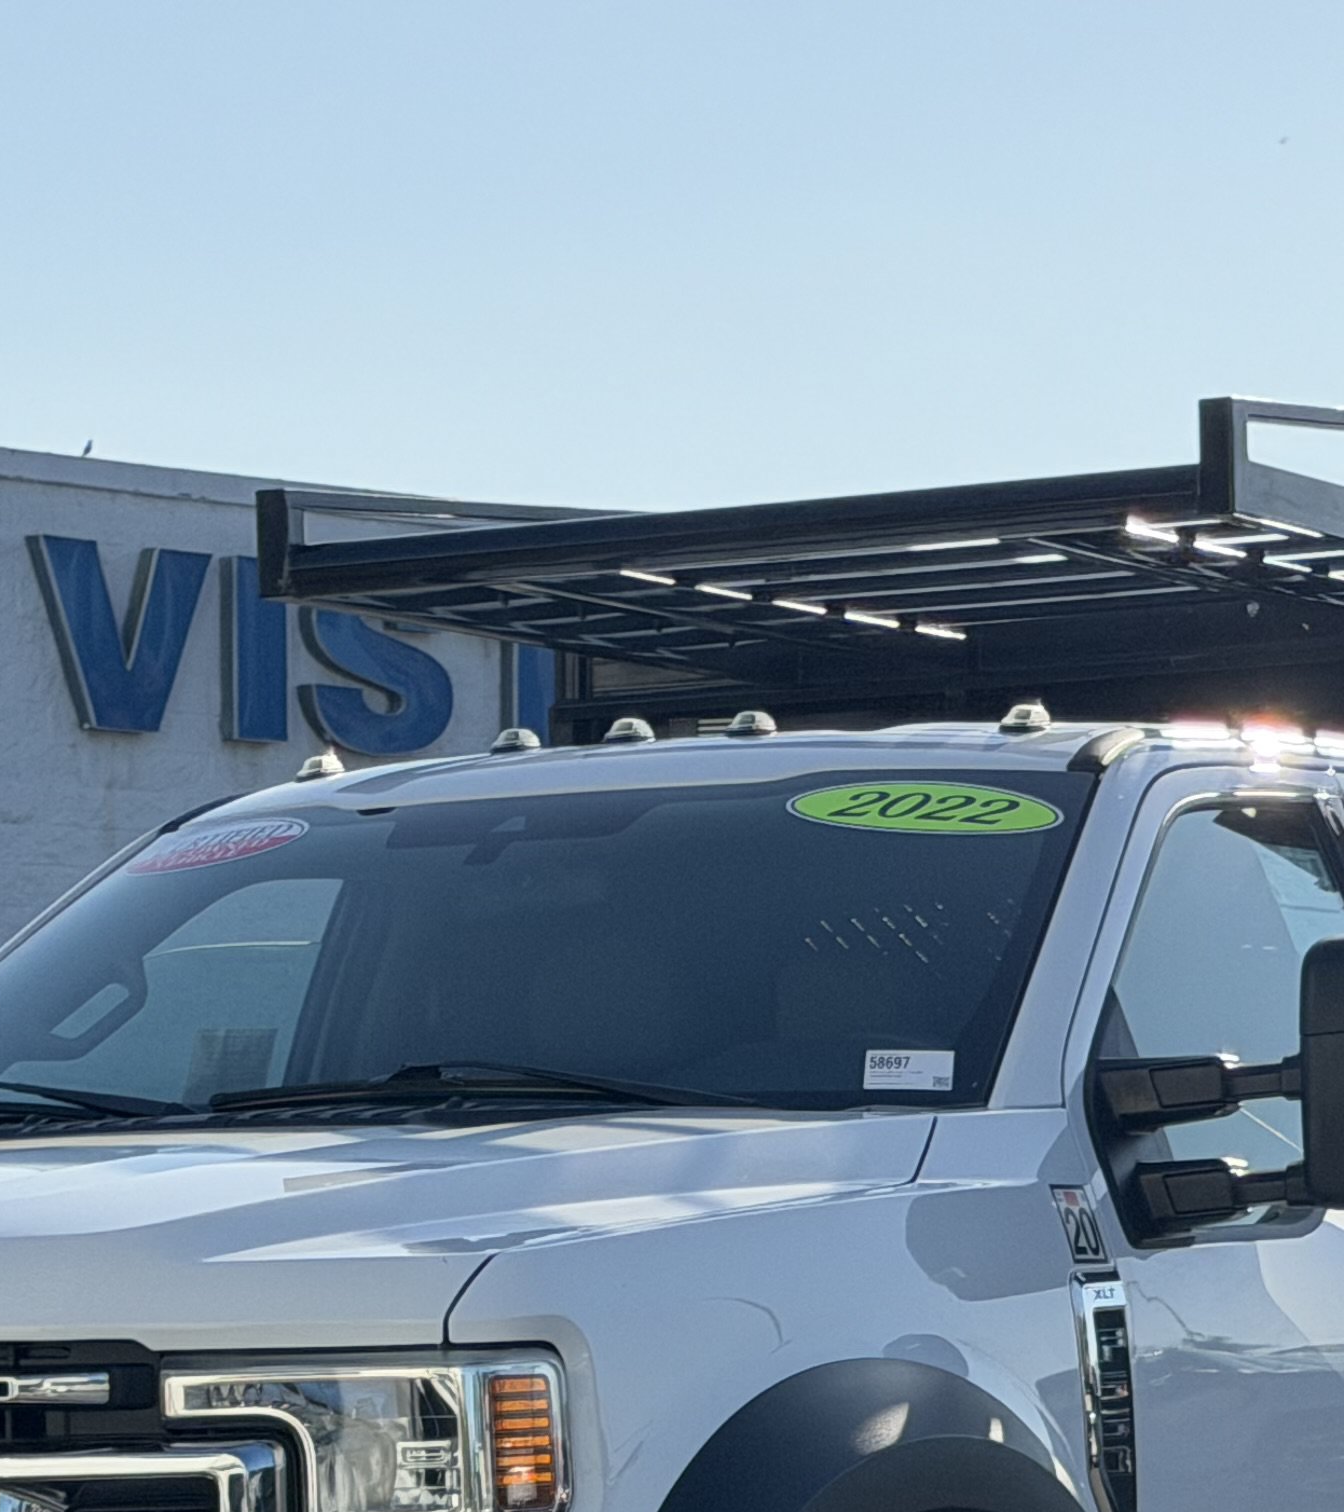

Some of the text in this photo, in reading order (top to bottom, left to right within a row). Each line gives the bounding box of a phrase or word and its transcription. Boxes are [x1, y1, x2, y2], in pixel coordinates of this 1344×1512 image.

[827, 790, 1020, 825] 2022
[869, 1055, 911, 1069] 58697
[1064, 1206, 1100, 1257] 20
[1093, 1287, 1116, 1300] XLT
